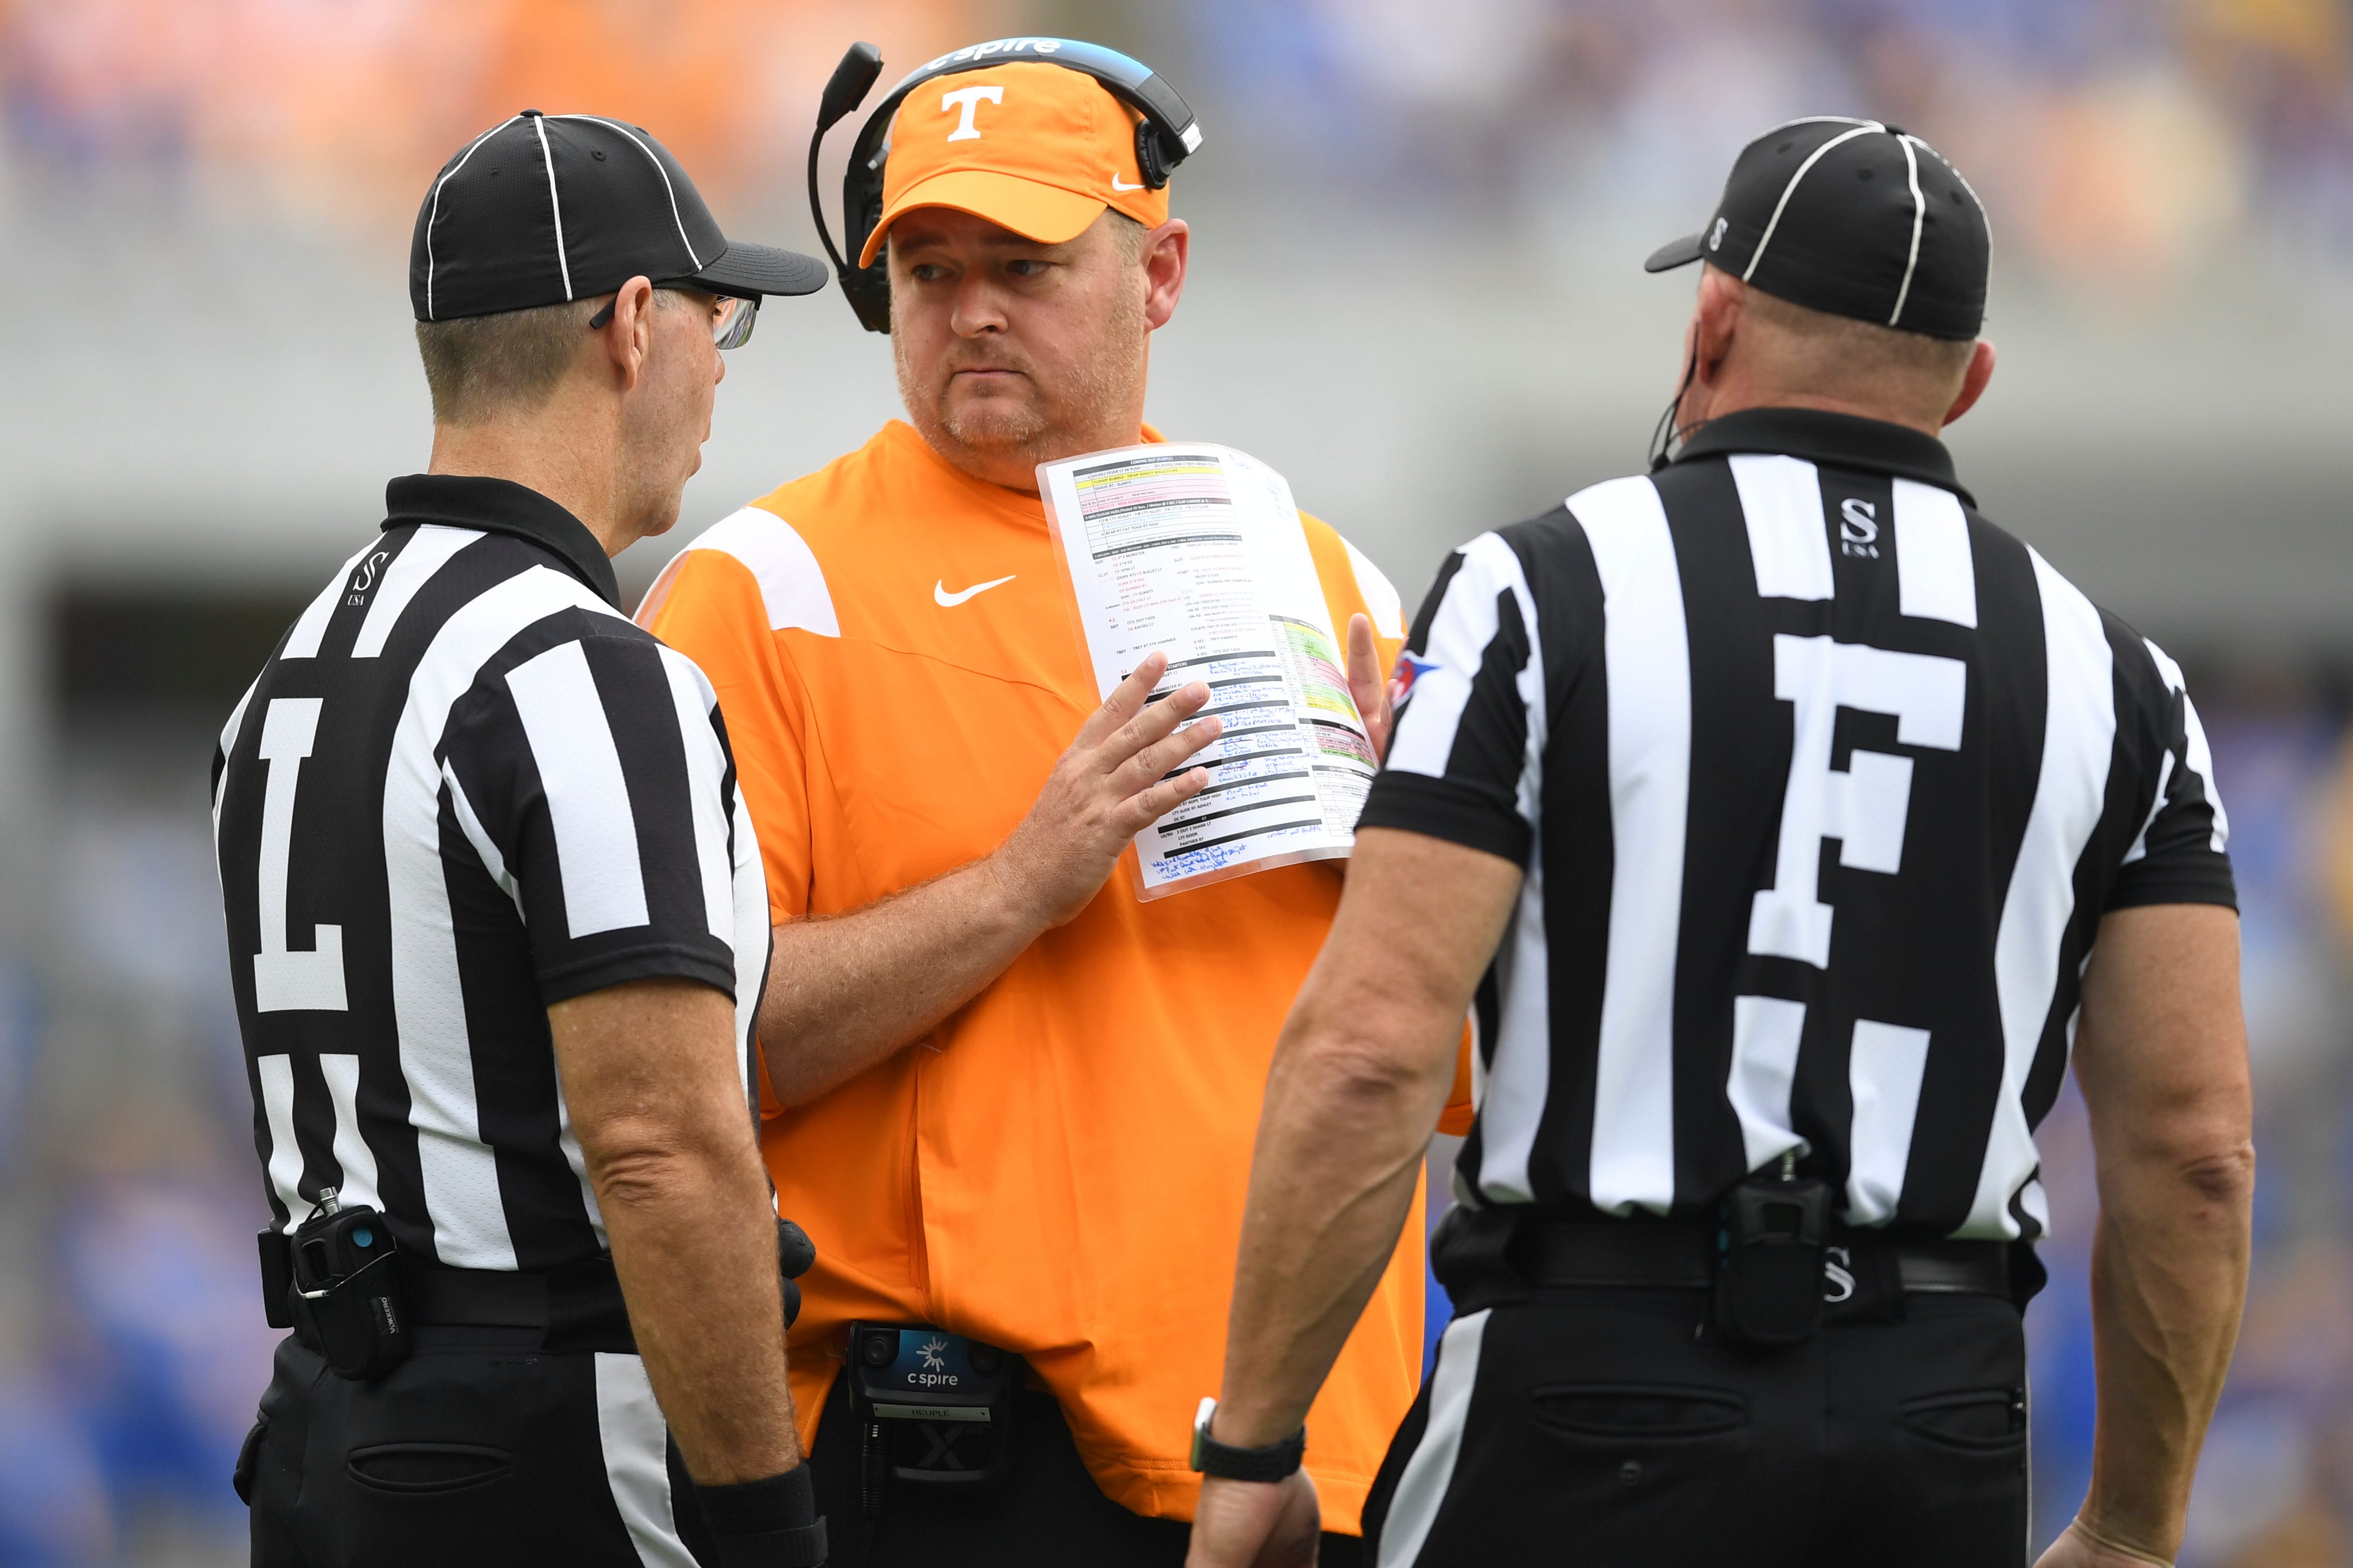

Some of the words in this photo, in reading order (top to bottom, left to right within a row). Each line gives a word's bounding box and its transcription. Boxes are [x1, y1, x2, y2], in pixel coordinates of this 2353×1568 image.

[954, 39, 1061, 61] spire
[942, 86, 1004, 143] T
[347, 594, 364, 606] USA
[1747, 633, 1967, 970] F
[253, 697, 349, 1013] L
[907, 1373, 917, 1384] c
[919, 1373, 958, 1388] spire
[911, 1409, 950, 1418] HEUPLE
